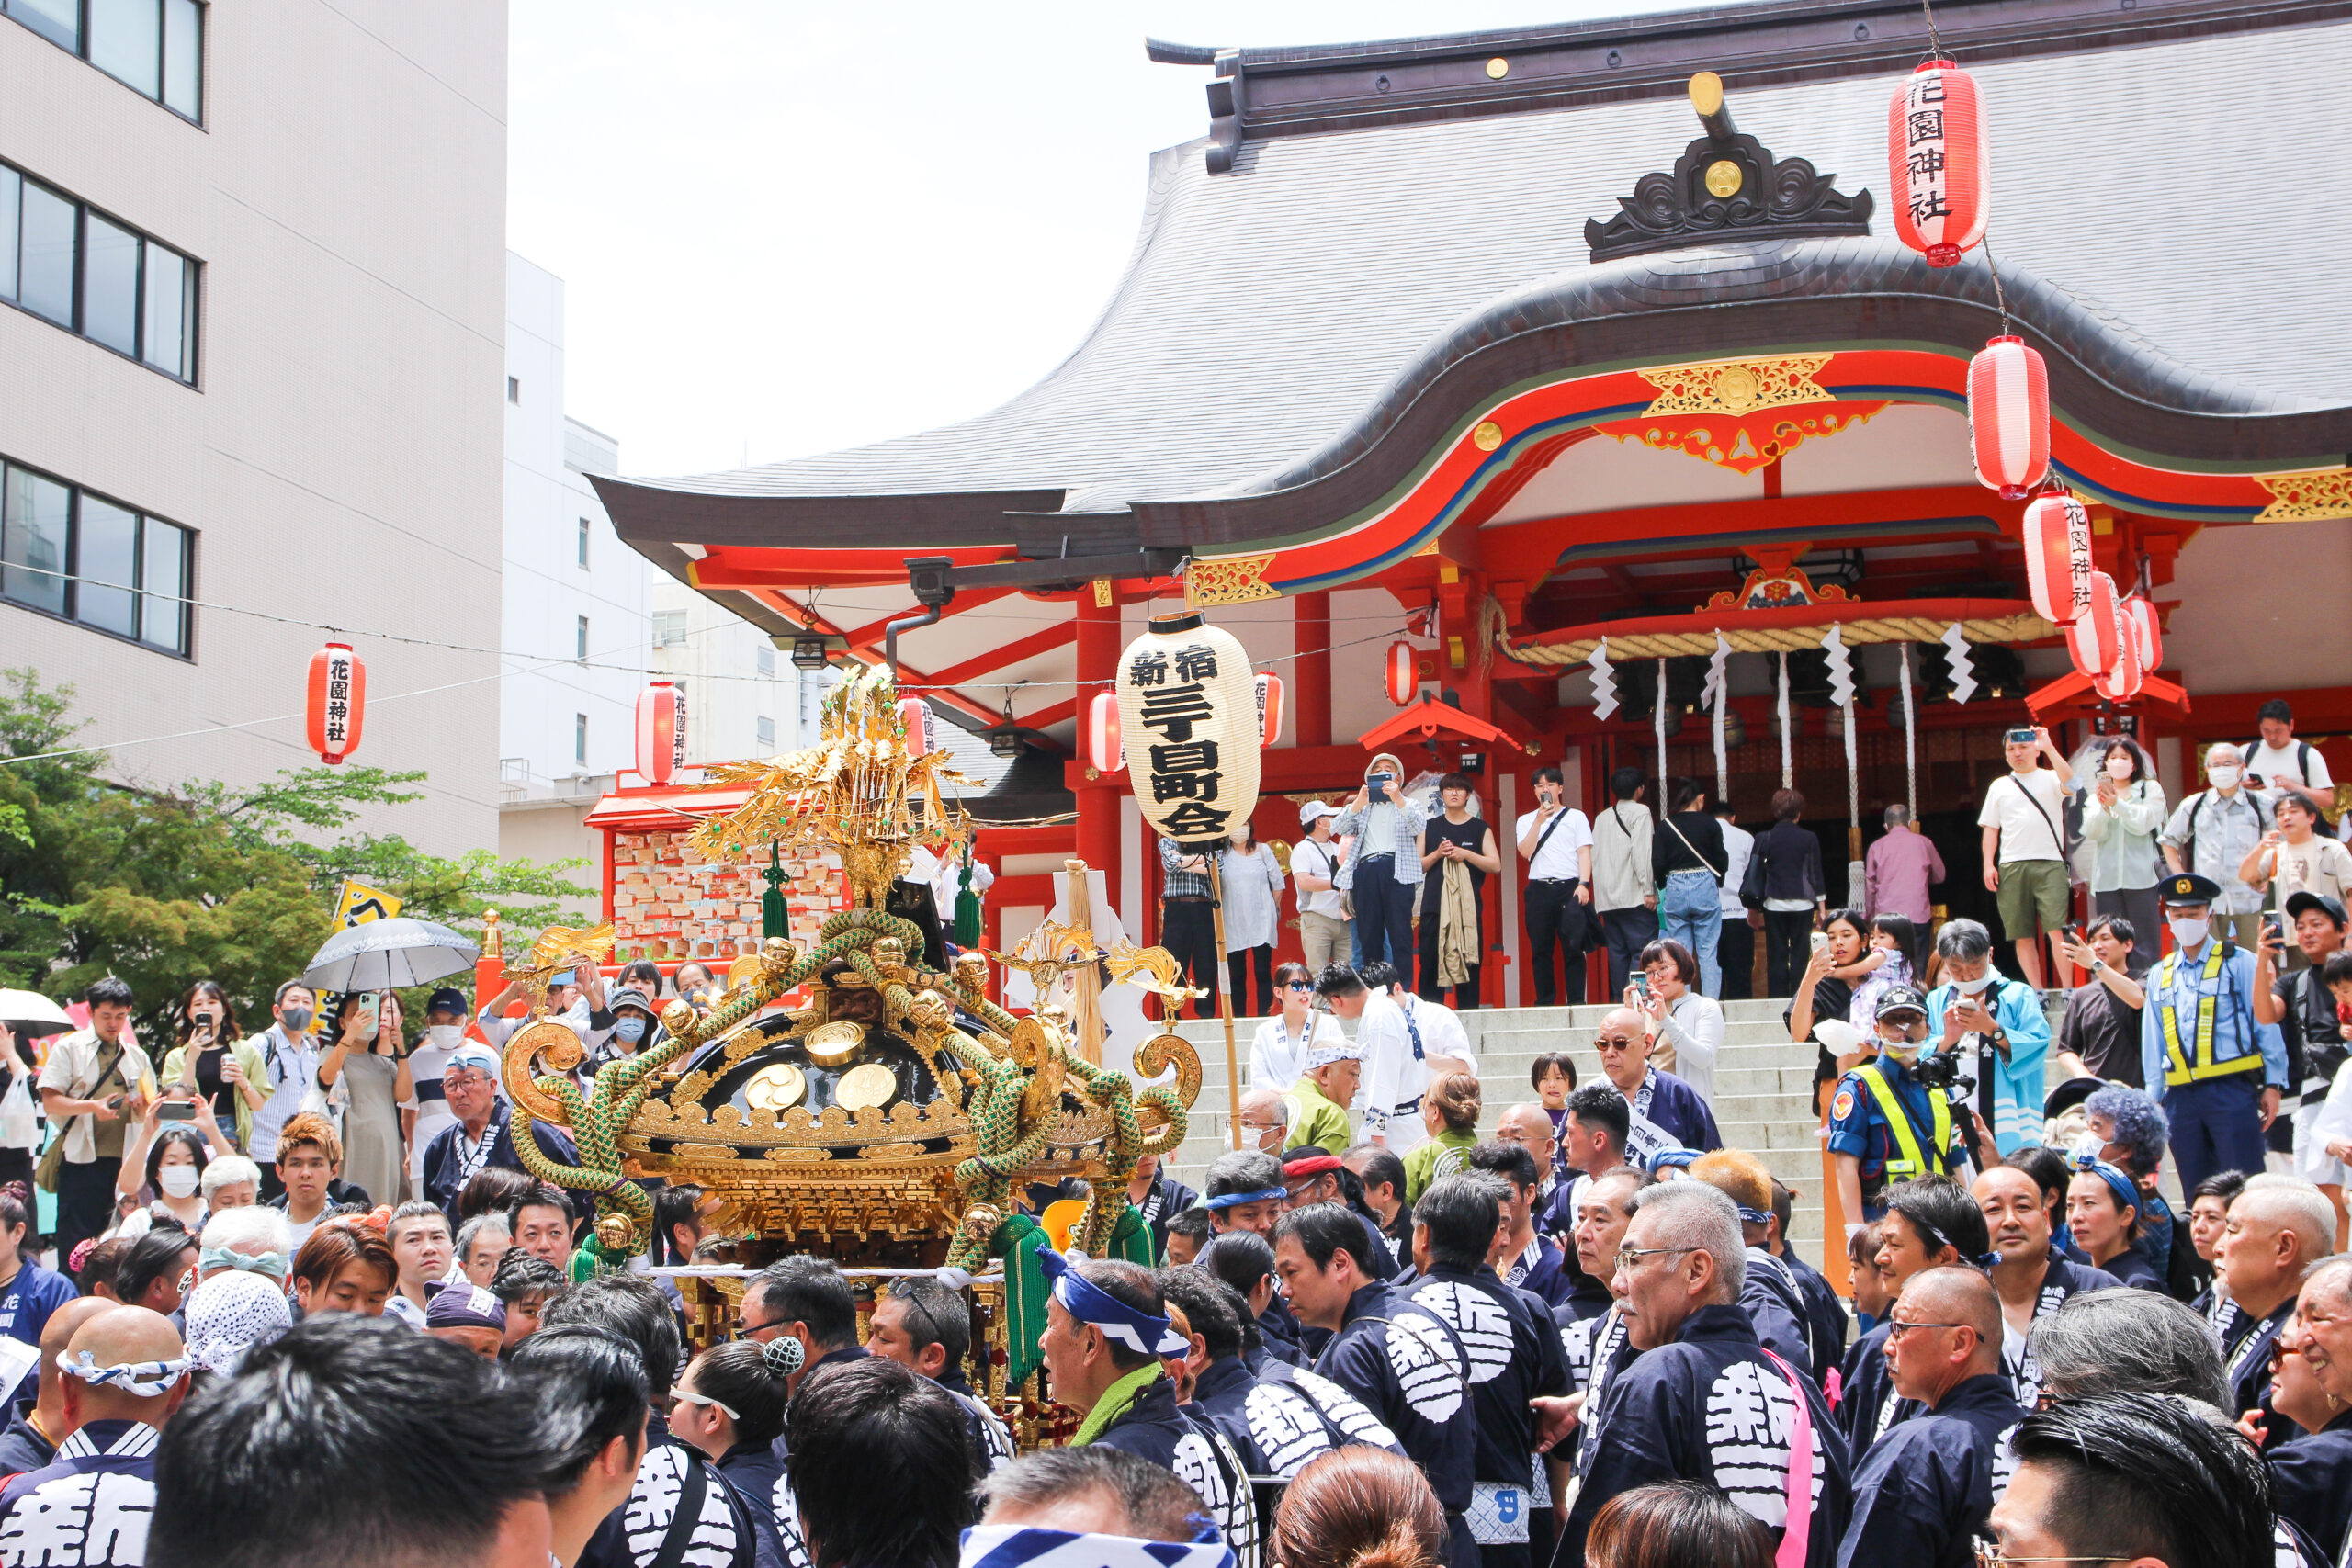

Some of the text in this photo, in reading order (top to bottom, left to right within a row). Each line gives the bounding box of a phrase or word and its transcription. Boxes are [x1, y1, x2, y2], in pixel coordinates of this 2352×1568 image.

[1901, 72, 1953, 227] 花園神社
[2064, 503, 2091, 606] 花園神社
[327, 659, 349, 741] 花園神社
[673, 696, 685, 769] 花園神社
